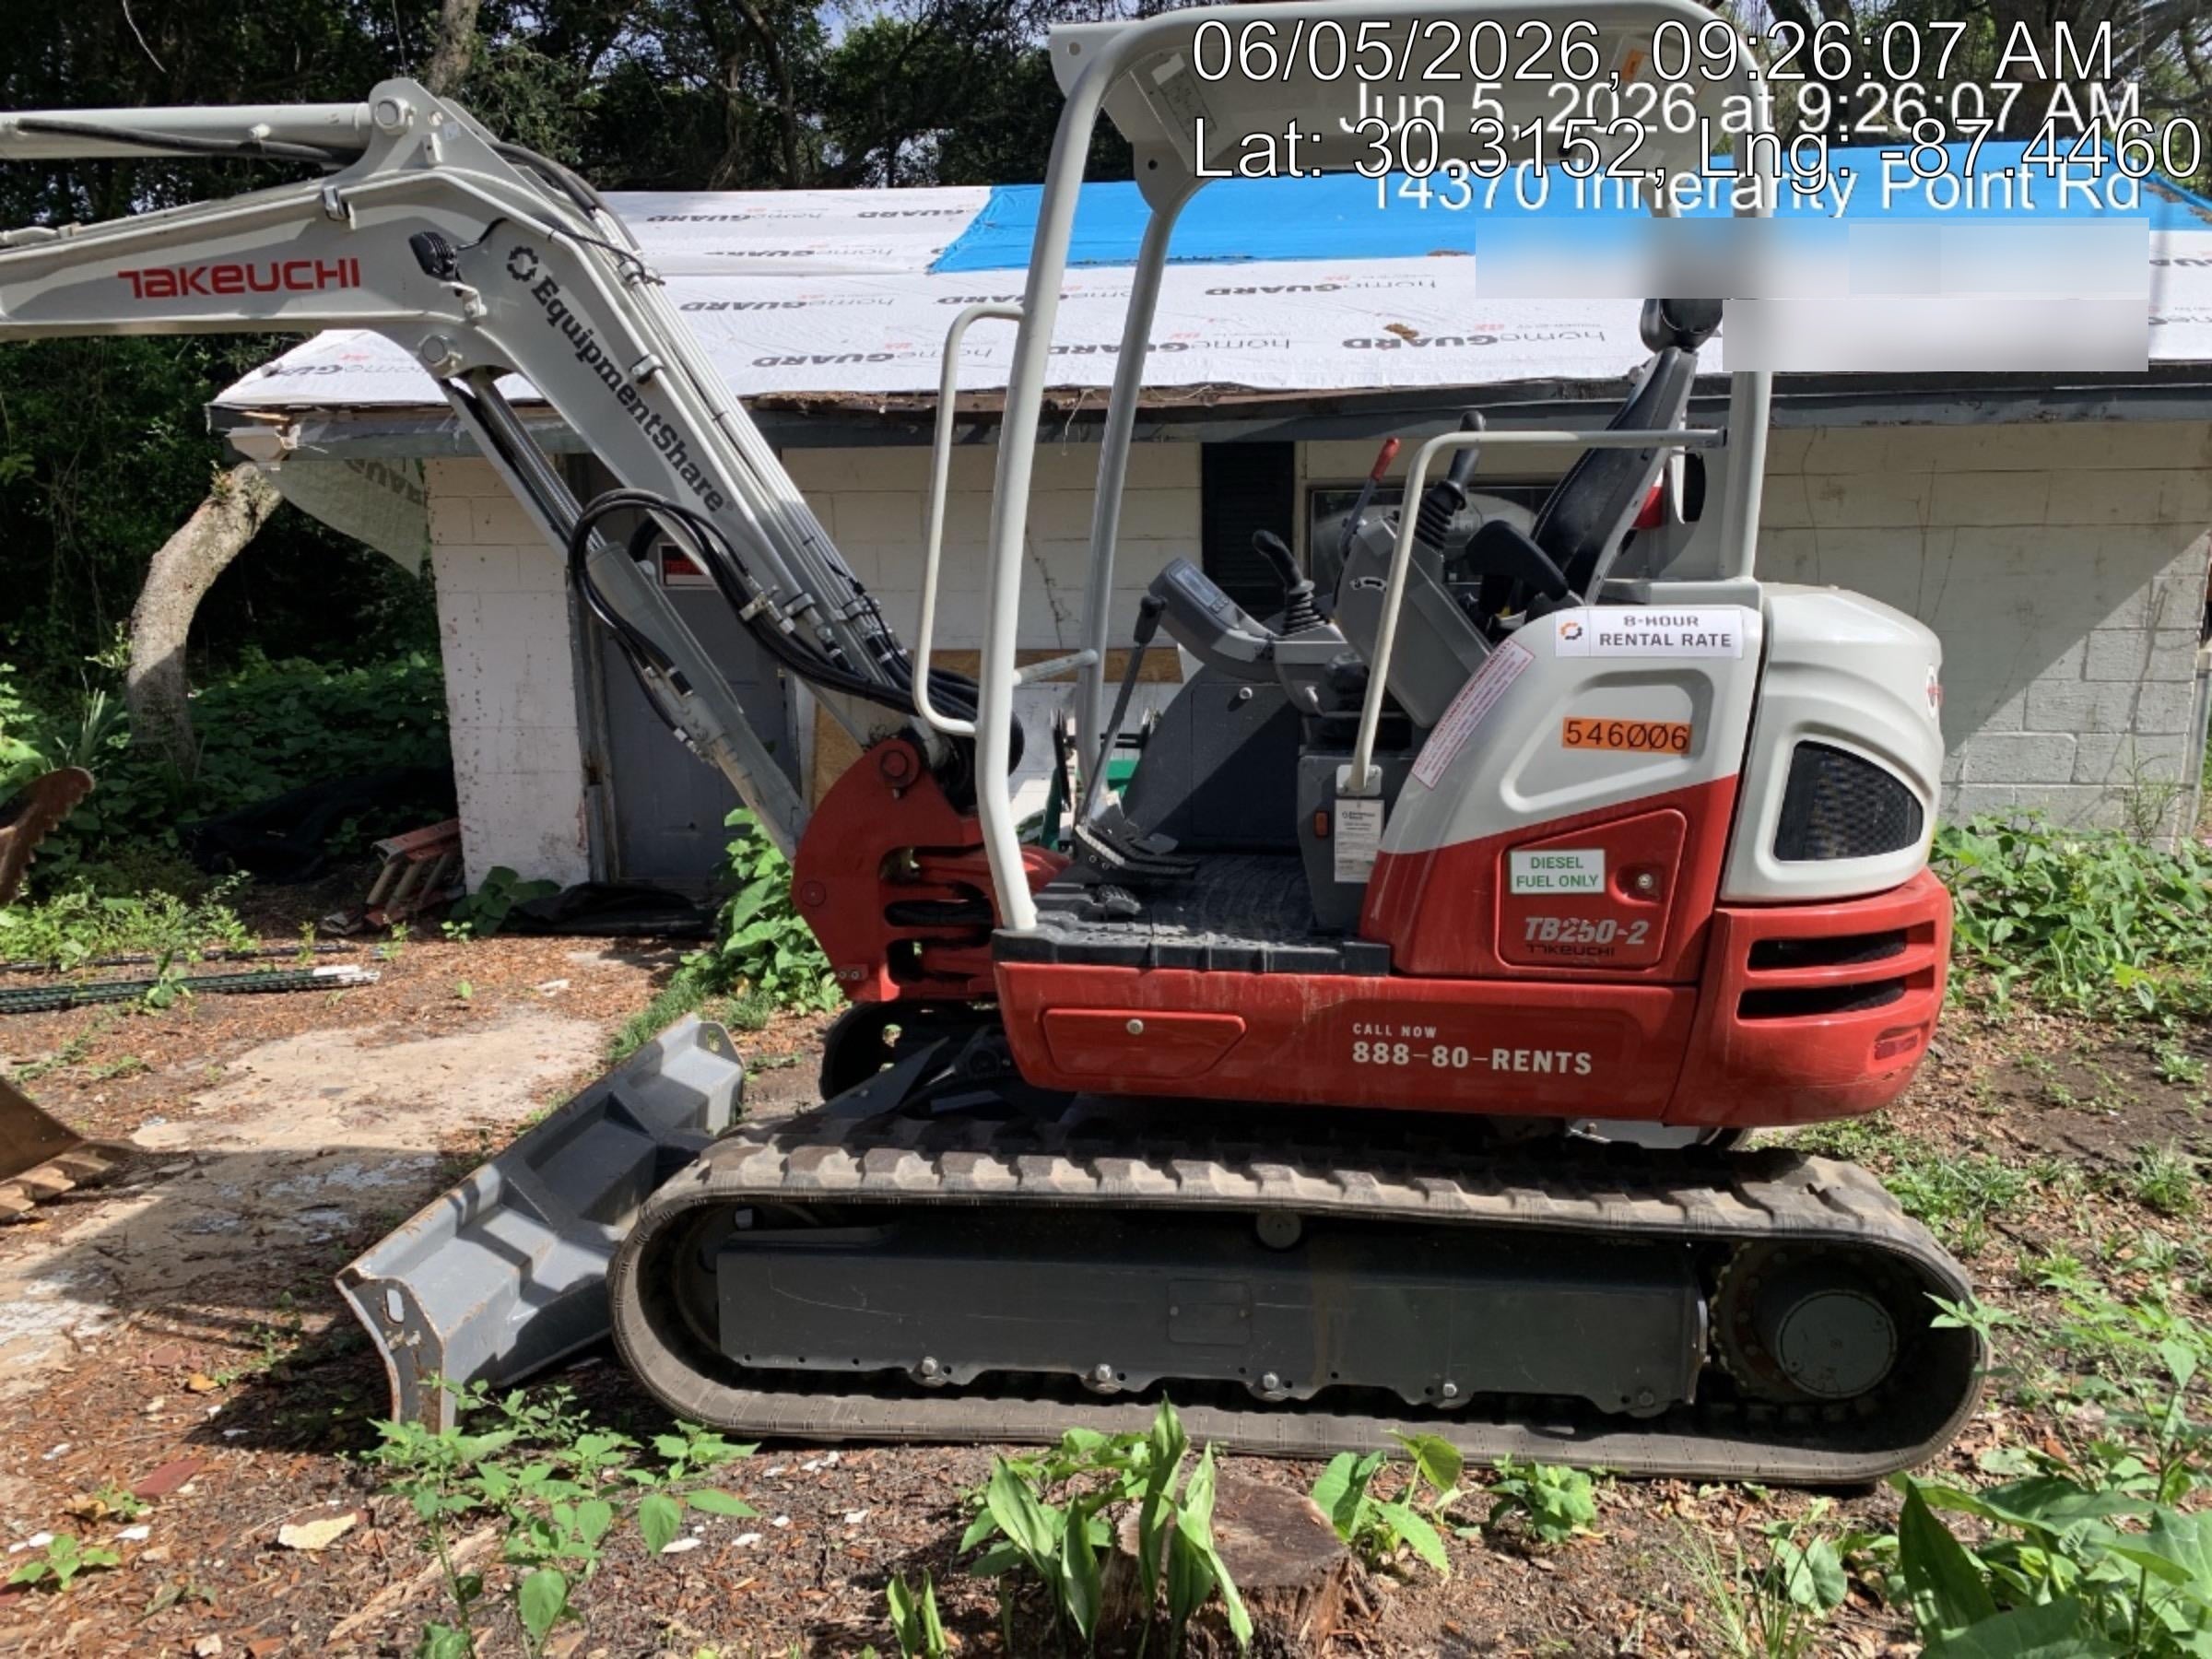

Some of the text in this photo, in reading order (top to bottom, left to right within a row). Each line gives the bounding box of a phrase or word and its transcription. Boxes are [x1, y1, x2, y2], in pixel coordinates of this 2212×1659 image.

[531, 275, 725, 512] EquipmentShare
[1624, 615, 1700, 628] 8-HOUR
[1599, 633, 1733, 648] RENTAL RATE
[1567, 721, 1688, 751] 546006
[1531, 856, 1584, 869] DIESEL
[1516, 875, 1599, 888] FUEL ONLY
[1524, 917, 1650, 946] TB250-2
[1352, 1023, 1437, 1039] CALL NOW
[1352, 1041, 1593, 1076] 888-80-RENTS
